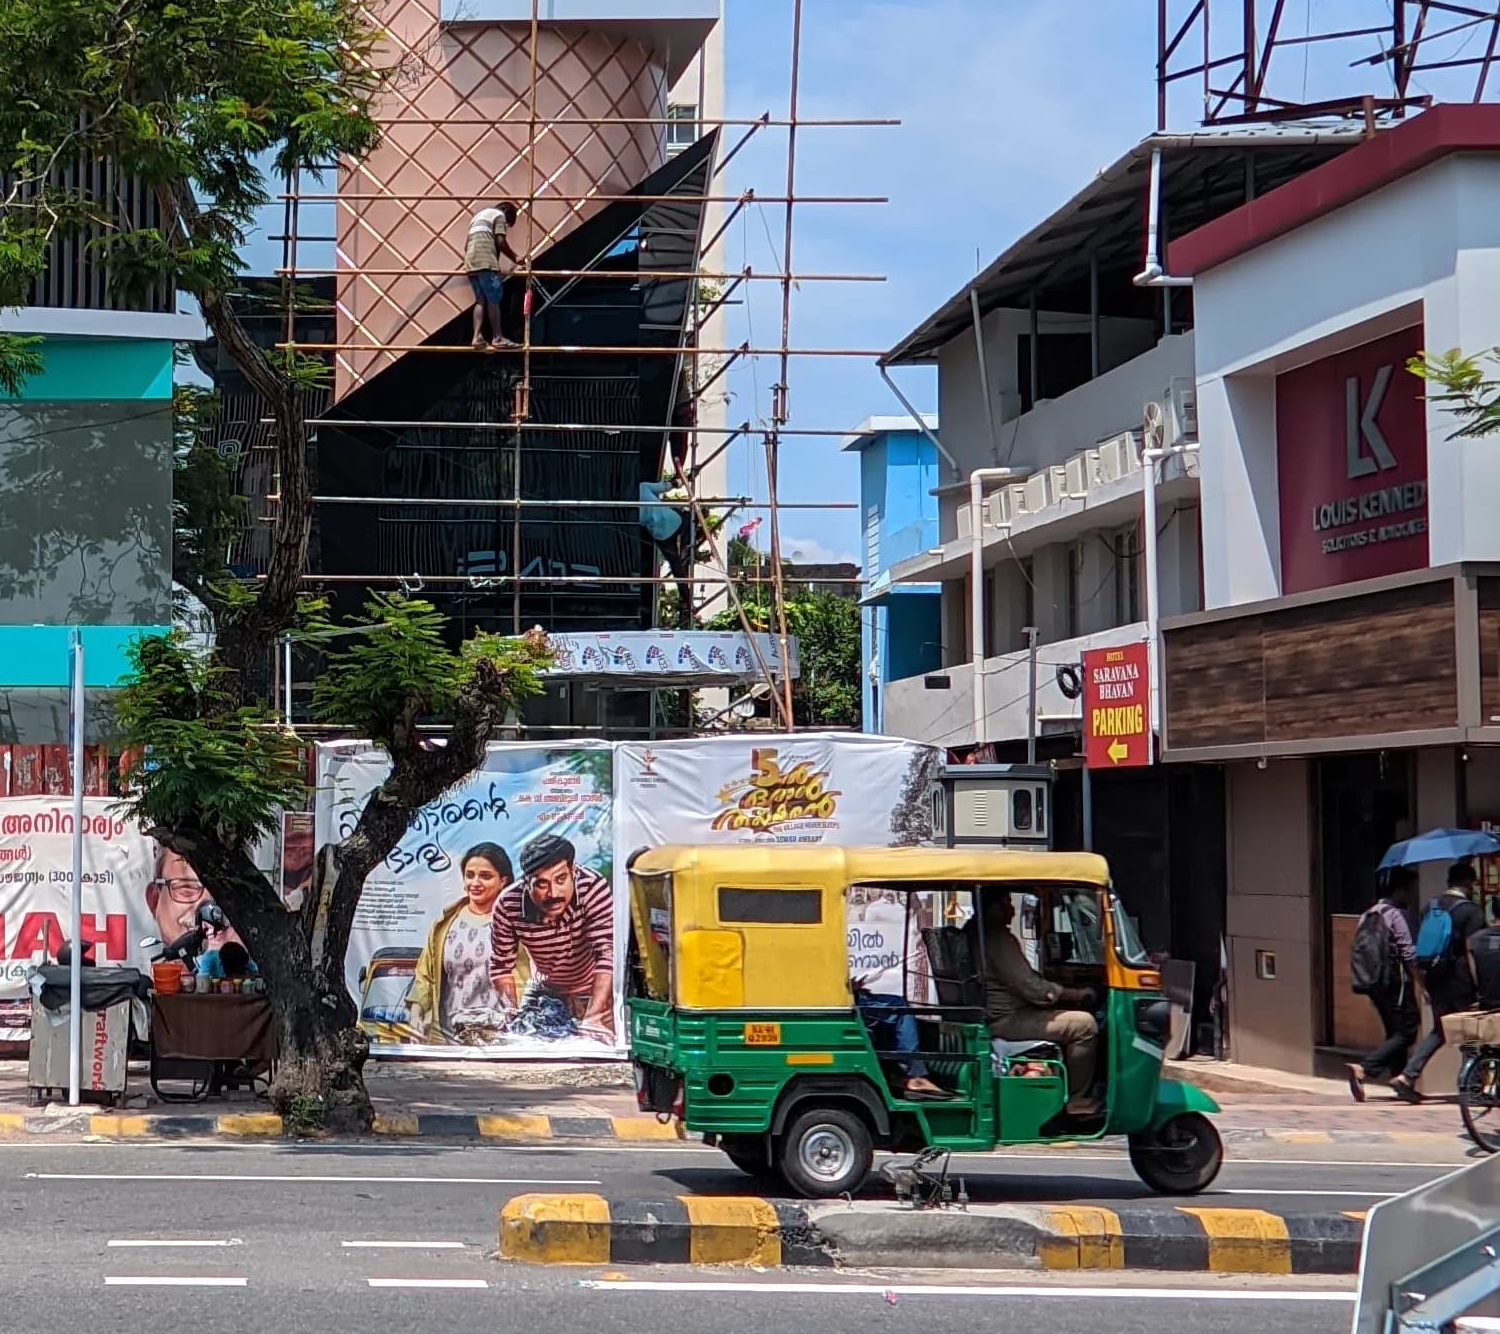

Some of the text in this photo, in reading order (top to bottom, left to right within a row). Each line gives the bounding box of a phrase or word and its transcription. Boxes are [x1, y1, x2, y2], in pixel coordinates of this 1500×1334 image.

[1312, 497, 1358, 532] LOUIS
[1093, 663, 1139, 684] SARAVANA
[1099, 681, 1134, 700] BHAVAN
[1092, 704, 1143, 737] PARKING
